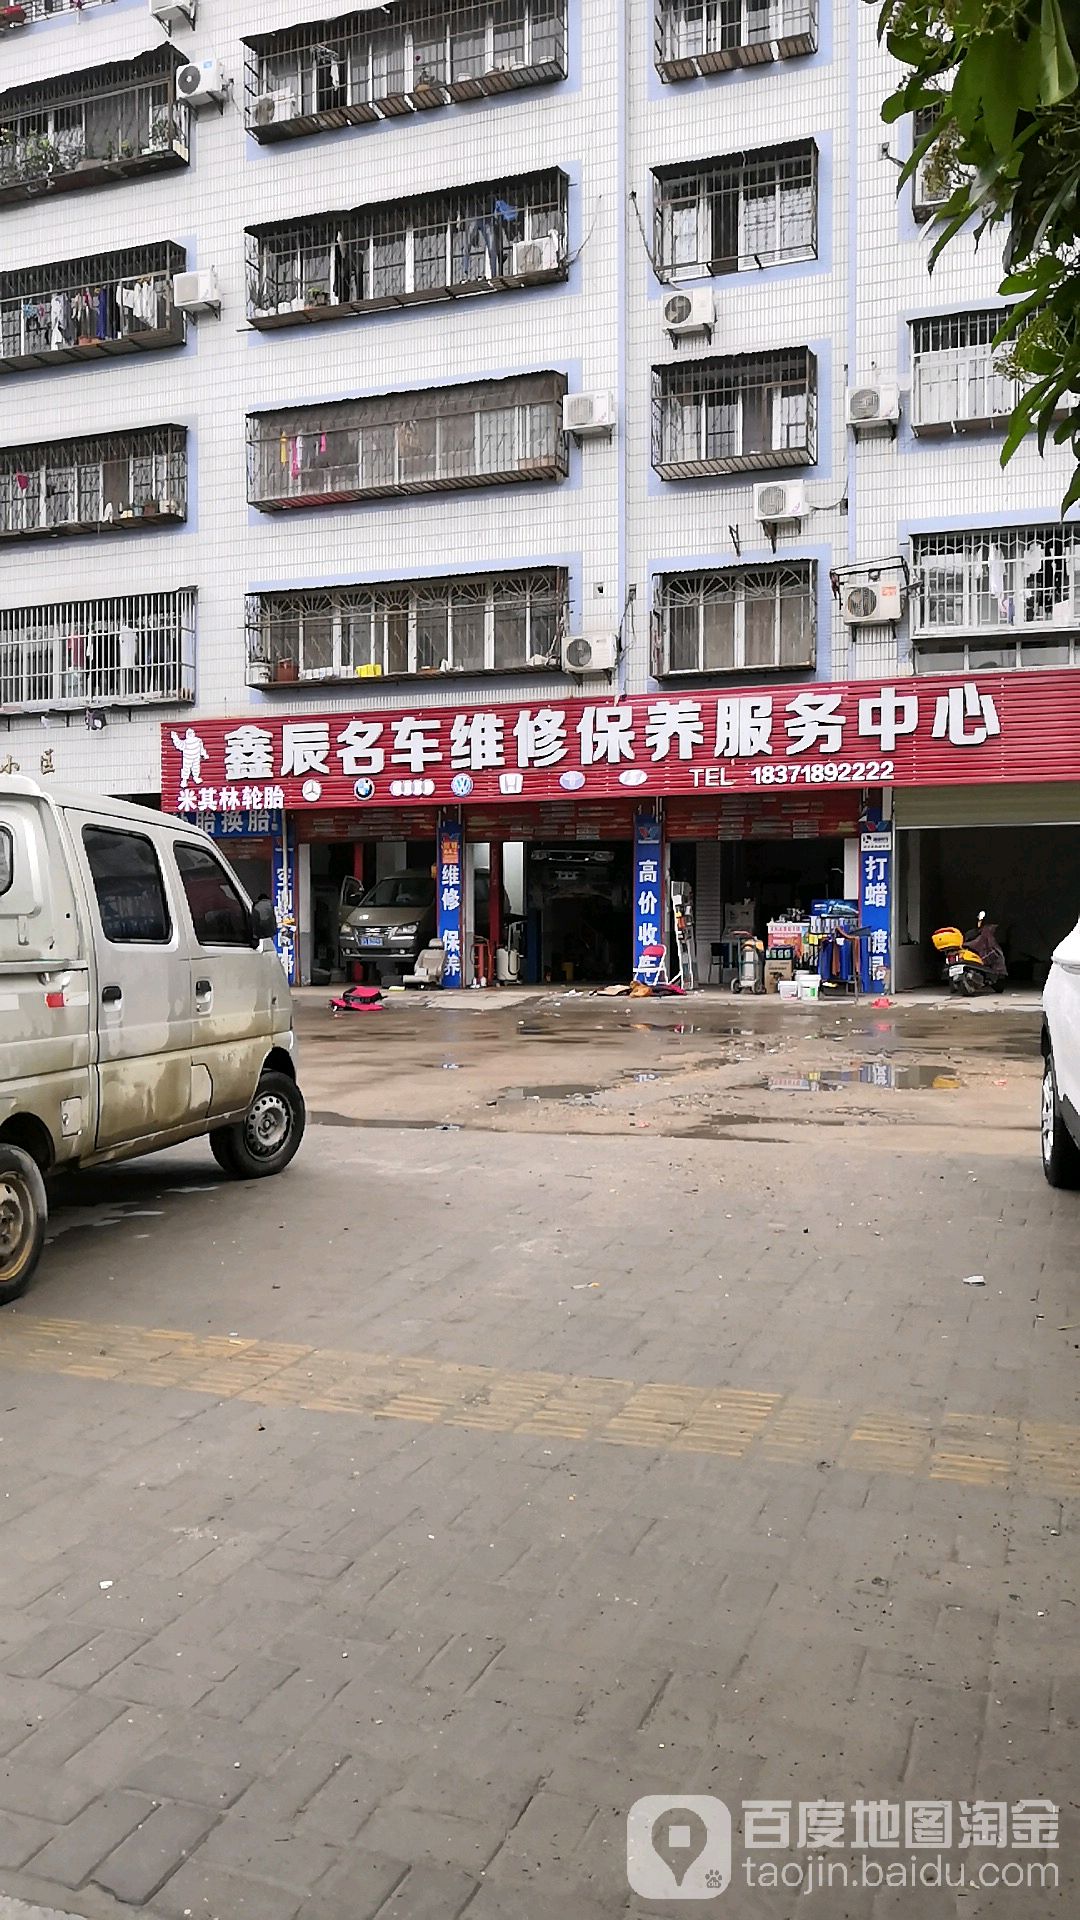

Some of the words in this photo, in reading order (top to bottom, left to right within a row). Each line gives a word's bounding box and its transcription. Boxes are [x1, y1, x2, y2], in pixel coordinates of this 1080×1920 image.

[224, 682, 1001, 781] 鑫辰名车维修保养服务中心
[689, 767, 735, 788] TEL
[750, 761, 895, 786] 18371892222
[178, 785, 285, 812] 米其林轮胎
[441, 864, 460, 911] 维修
[865, 855, 888, 907] 打蜡
[442, 929, 461, 976] 保养
